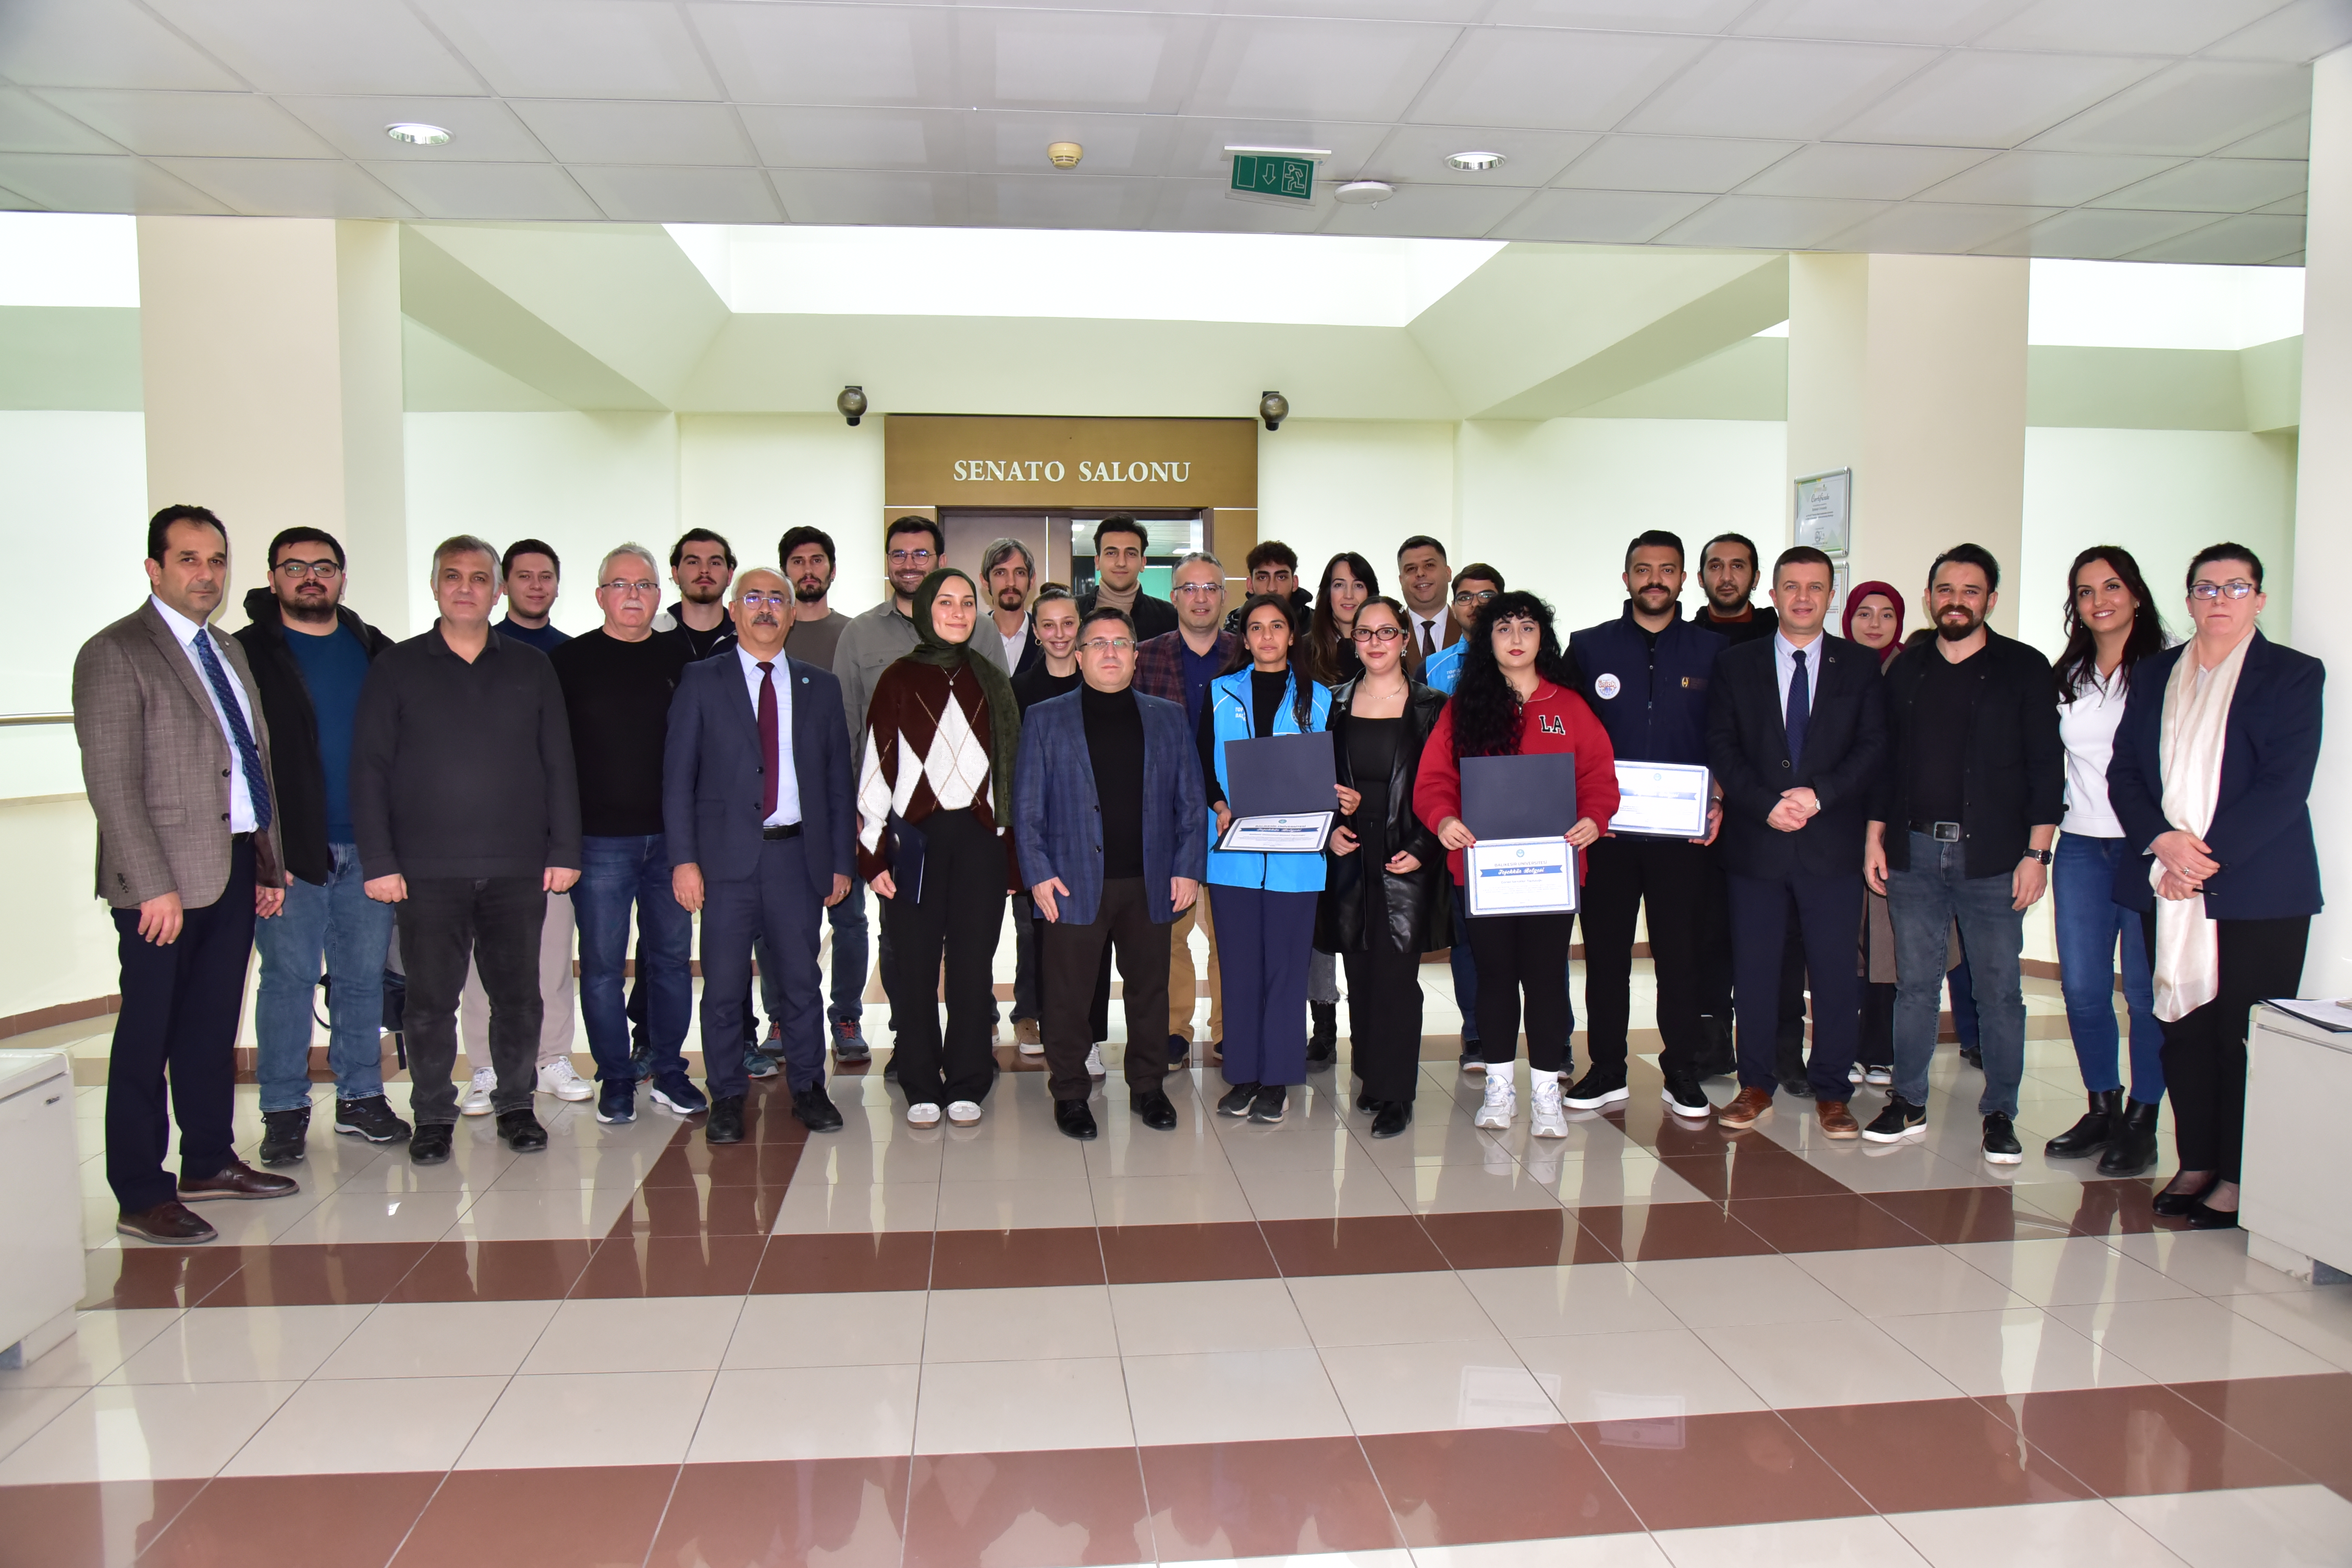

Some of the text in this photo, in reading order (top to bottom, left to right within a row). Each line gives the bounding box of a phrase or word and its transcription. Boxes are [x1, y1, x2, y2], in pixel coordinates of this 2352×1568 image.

[953, 460, 1191, 482] SENATO SALONU
[1811, 492, 1830, 503] Certificate
[1539, 715, 1565, 736] LA
